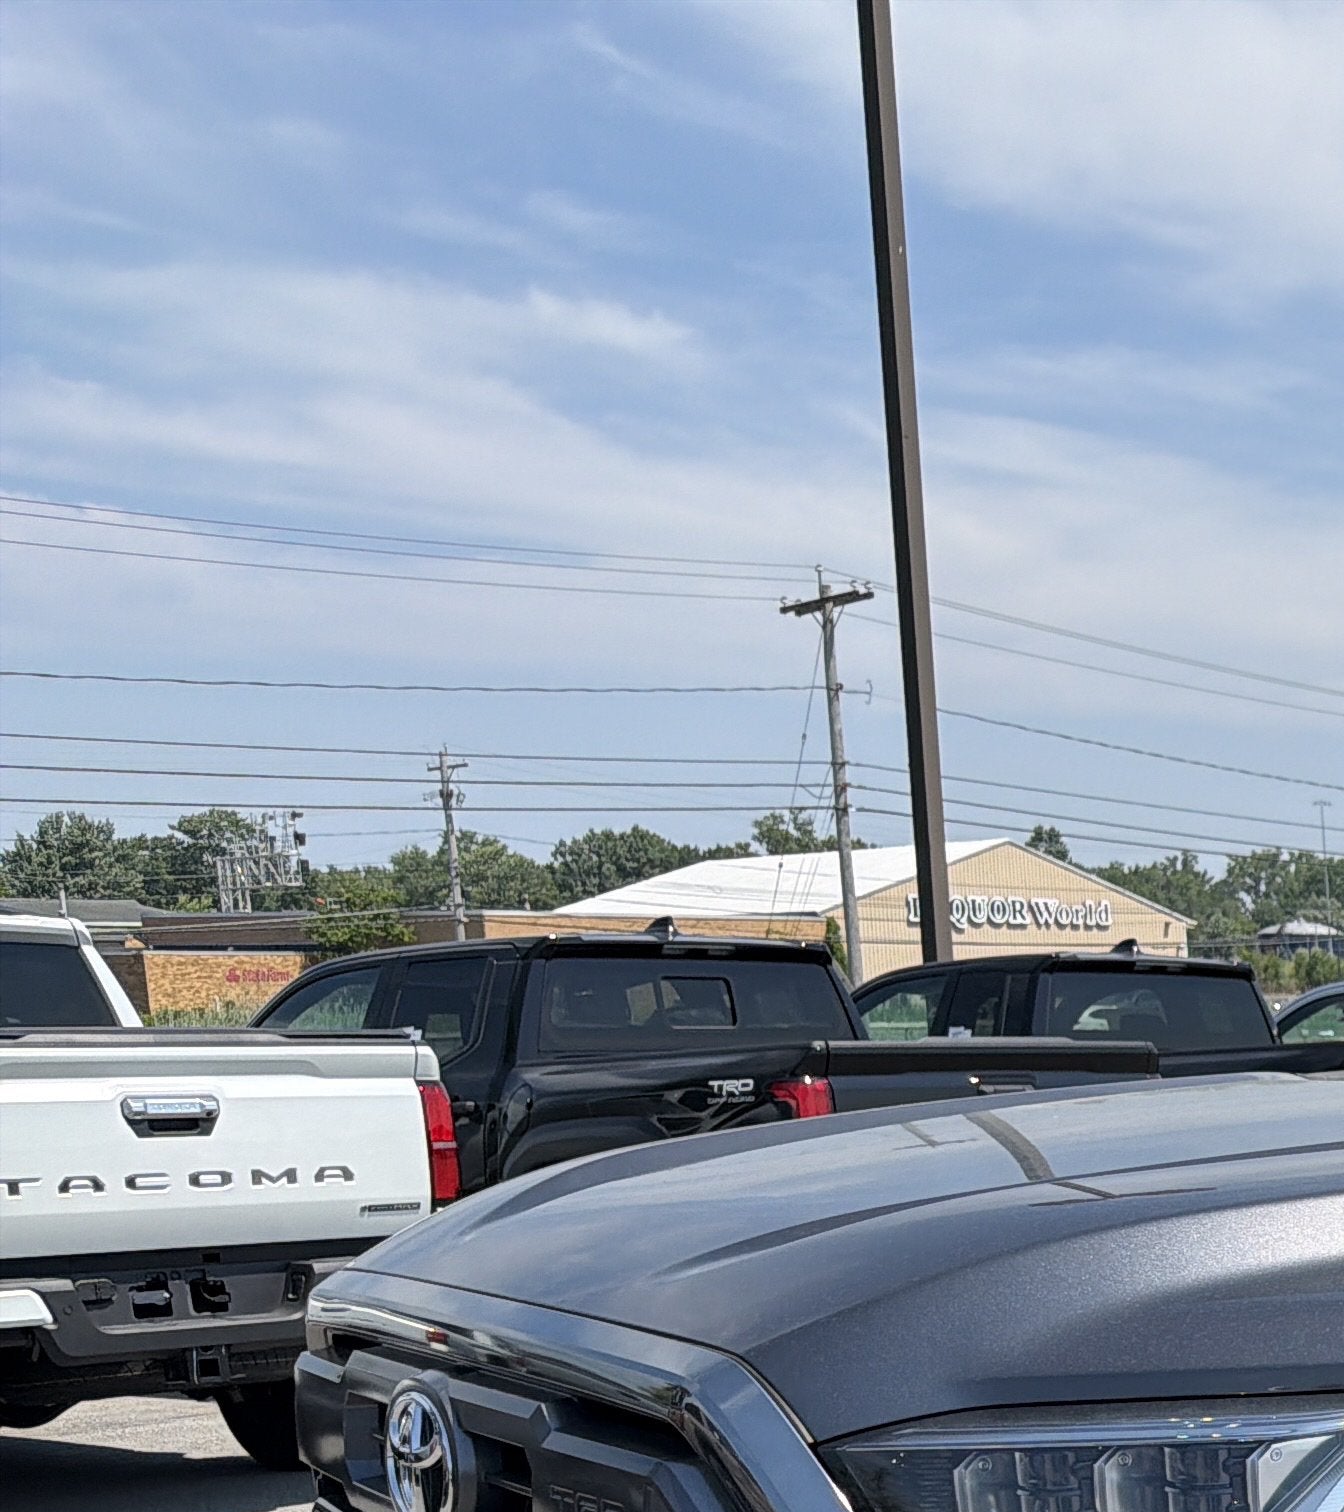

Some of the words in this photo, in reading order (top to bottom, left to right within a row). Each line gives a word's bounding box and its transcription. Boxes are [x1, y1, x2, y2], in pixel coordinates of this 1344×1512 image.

[907, 893, 1030, 929] LQUOR
[1031, 898, 1114, 926] World
[708, 1079, 754, 1096] TRD
[0, 1165, 356, 1197] TACOMA
